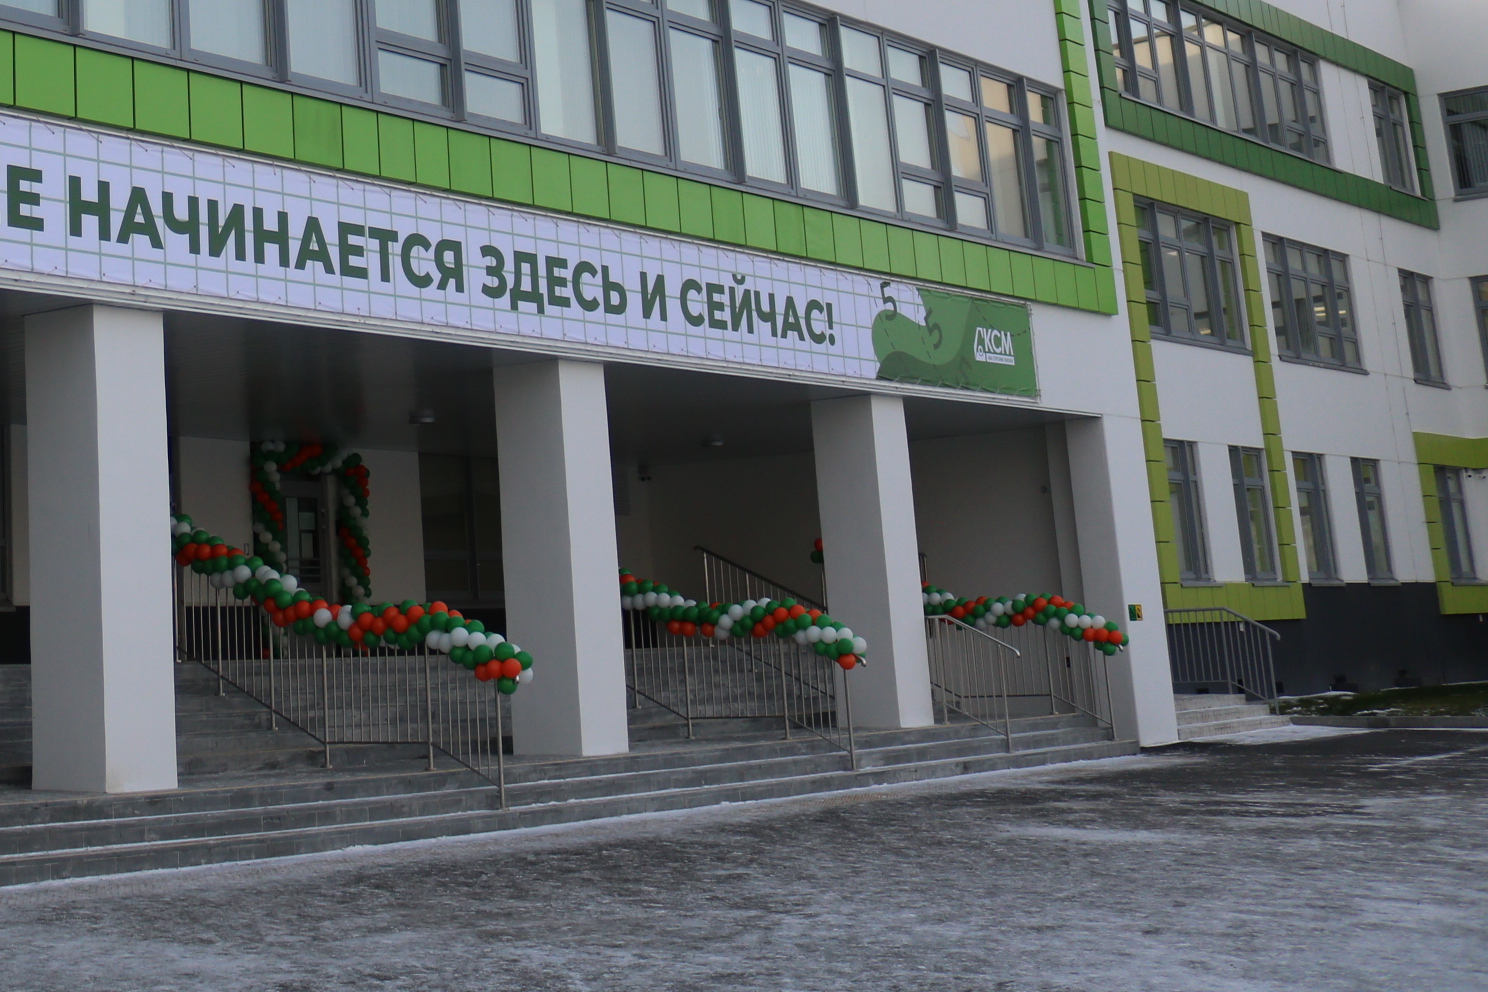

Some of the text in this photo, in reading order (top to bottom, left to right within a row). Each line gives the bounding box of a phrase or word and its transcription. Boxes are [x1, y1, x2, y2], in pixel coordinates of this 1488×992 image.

[69, 176, 466, 294] НАЧИНАЕТСЯ
[480, 245, 628, 314] ЗДЕСЬ
[639, 271, 668, 322] И
[680, 274, 836, 346] СЕЙЧАС!
[880, 281, 898, 321] 5
[924, 307, 943, 350] 5
